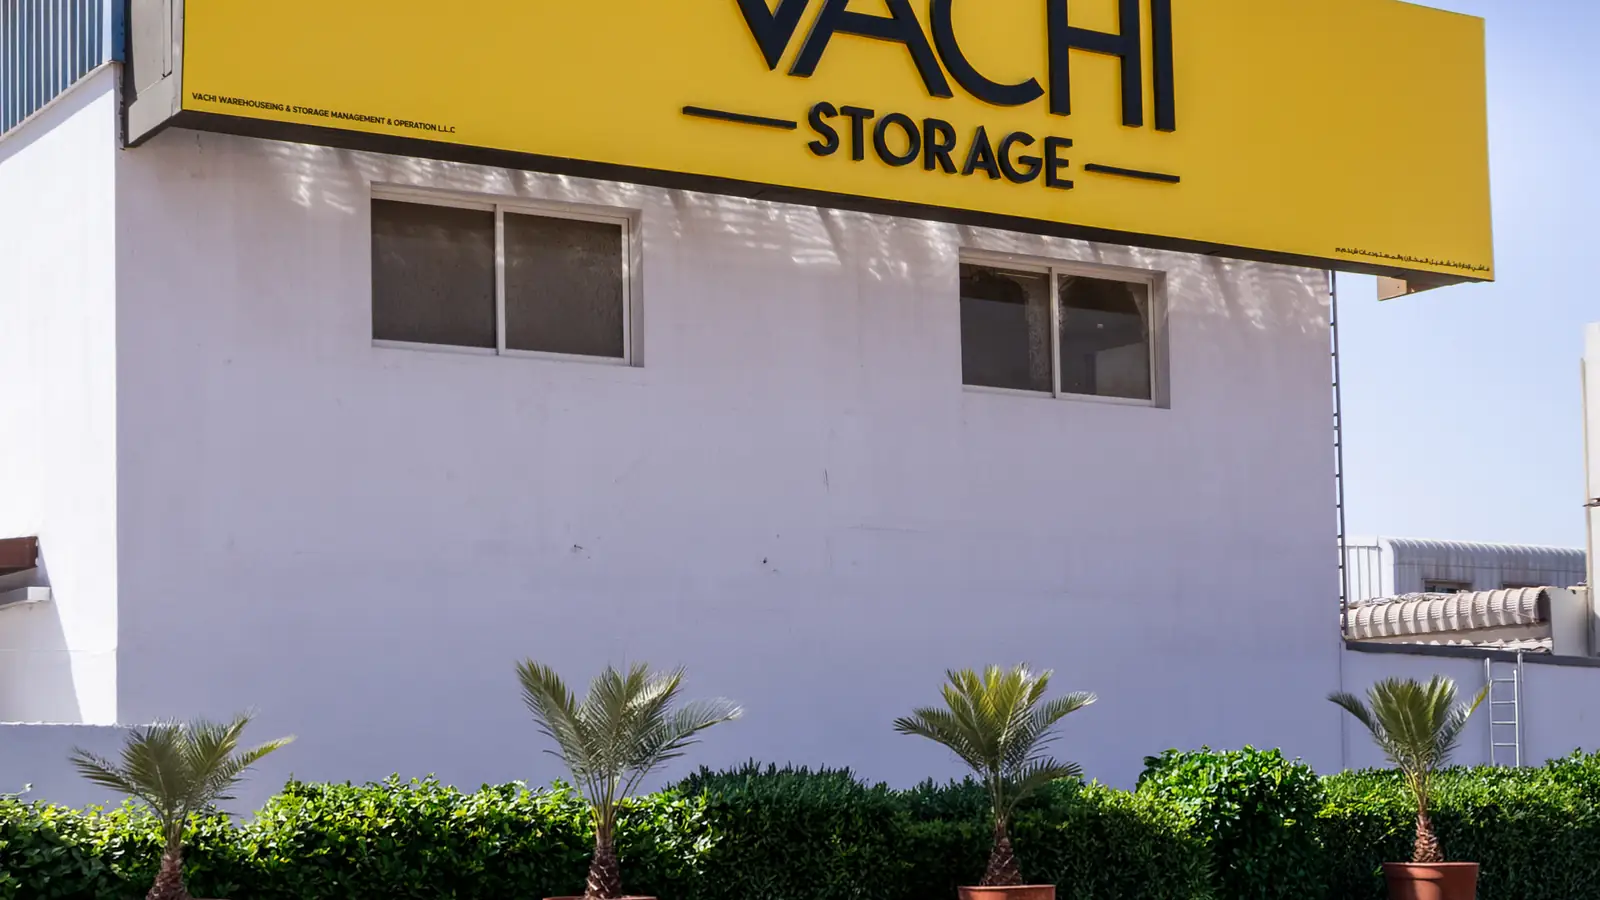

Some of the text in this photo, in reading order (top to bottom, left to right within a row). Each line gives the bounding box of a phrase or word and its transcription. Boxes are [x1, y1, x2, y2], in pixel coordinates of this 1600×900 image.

[736, 0, 1176, 132] VACHI
[191, 92, 217, 103] VACHI
[218, 96, 284, 112] WAREHOUSEING
[285, 105, 291, 113] &
[292, 106, 330, 118] STORAGE
[330, 111, 386, 125] MANAGEMENT
[386, 118, 392, 126] &
[393, 119, 437, 131] OPERATION
[807, 101, 1074, 190] STORAGE
